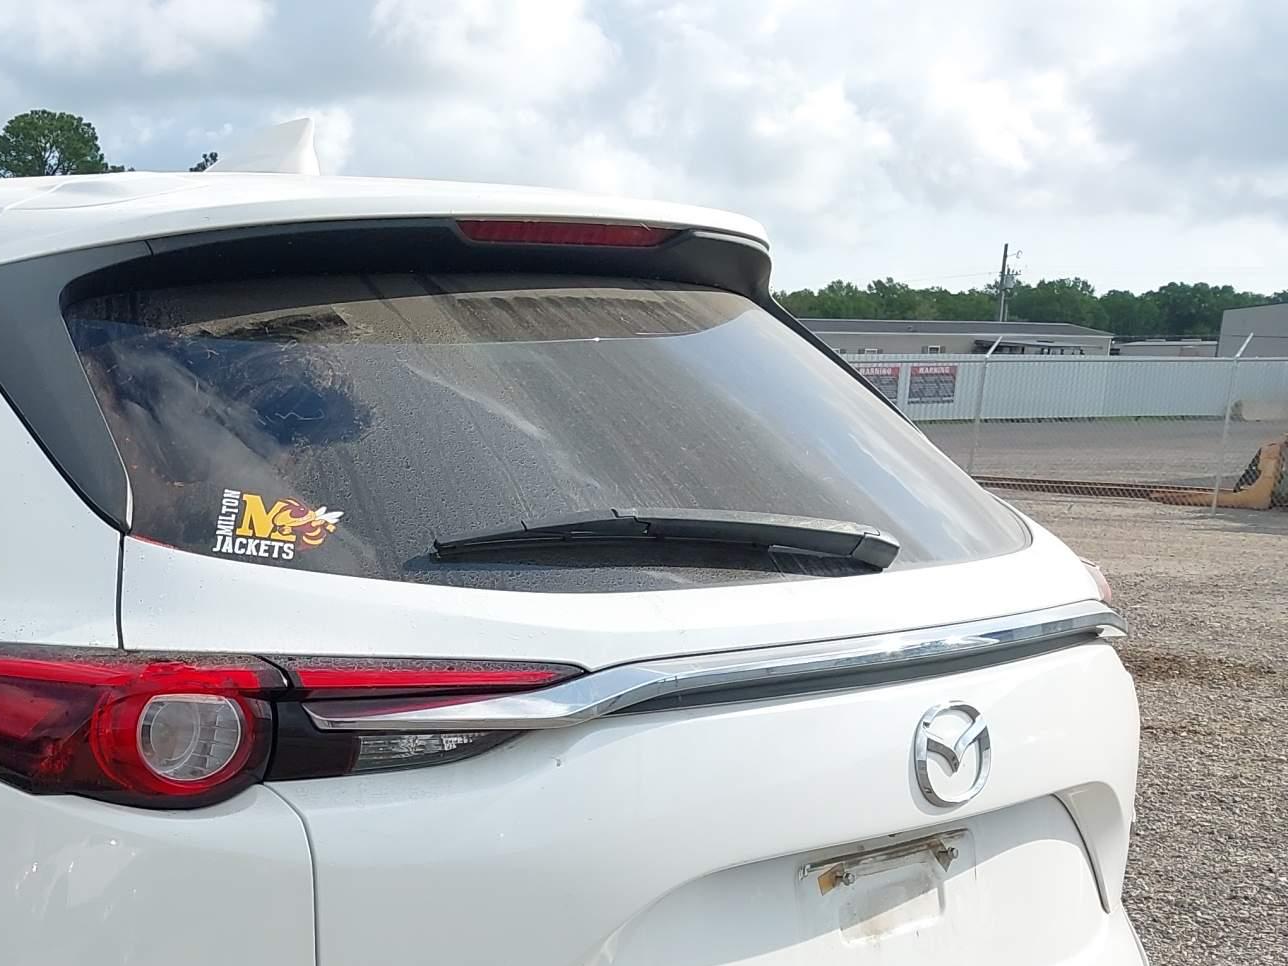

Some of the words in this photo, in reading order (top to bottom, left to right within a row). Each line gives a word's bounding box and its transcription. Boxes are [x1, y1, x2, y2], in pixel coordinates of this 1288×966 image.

[918, 366, 950, 374] WARNING
[216, 488, 241, 536] MILTON
[212, 535, 295, 560] JACKETS
